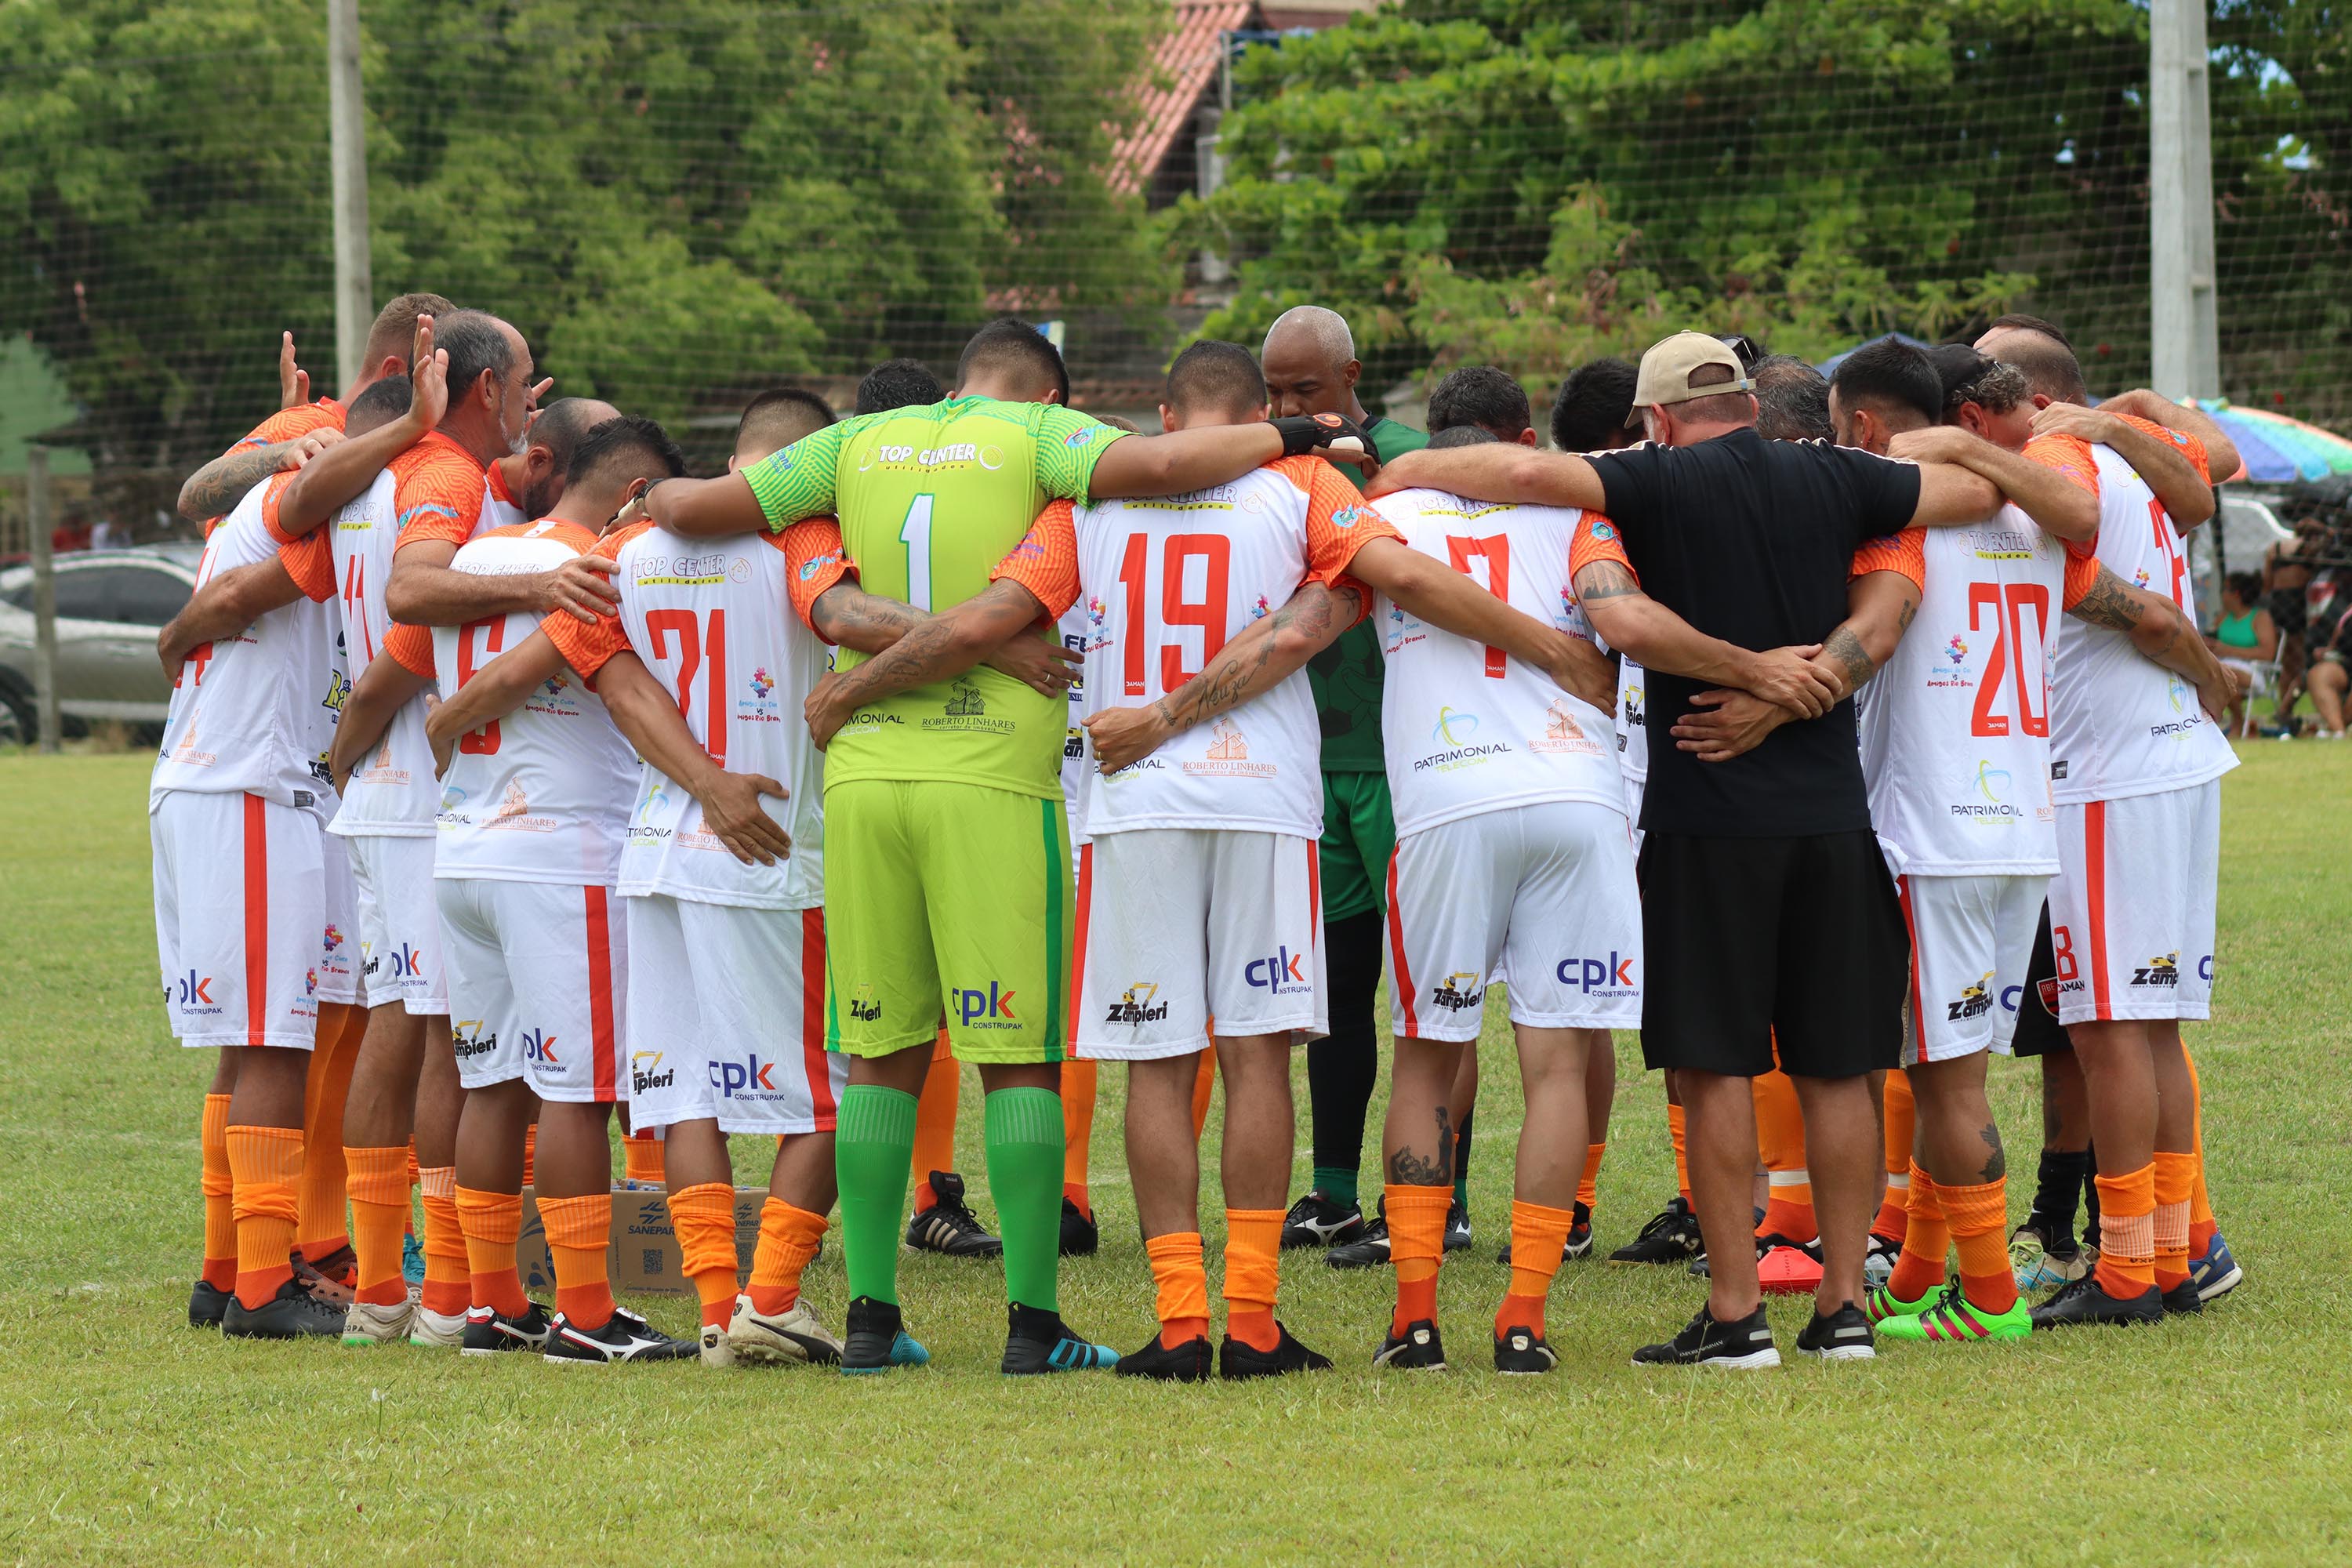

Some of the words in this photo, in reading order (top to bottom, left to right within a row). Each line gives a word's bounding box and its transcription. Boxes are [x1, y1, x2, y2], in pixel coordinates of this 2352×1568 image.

[879, 445, 913, 462] TOP
[918, 443, 978, 466] CENTER
[1417, 496, 1450, 510] TOP
[636, 556, 668, 578] TOP
[673, 554, 726, 576] CENTER
[899, 493, 935, 613] 1
[1119, 533, 1231, 695] 19
[1446, 532, 1509, 679] 7
[1969, 583, 2049, 738] 20
[922, 717, 965, 727] ROBERTO
[967, 717, 1015, 729] LINHARES
[1182, 761, 1229, 770] ROBERTO
[1231, 761, 1277, 772] LINHARES
[1414, 742, 1512, 772] PATRIMONIAL
[678, 832, 710, 844] ROBERTO
[1244, 945, 1305, 994] cpk
[1557, 951, 1634, 993] cpk
[952, 981, 1016, 1026] cpk
[1105, 1000, 1168, 1027] Zampieri
[709, 1054, 775, 1098] cpk
